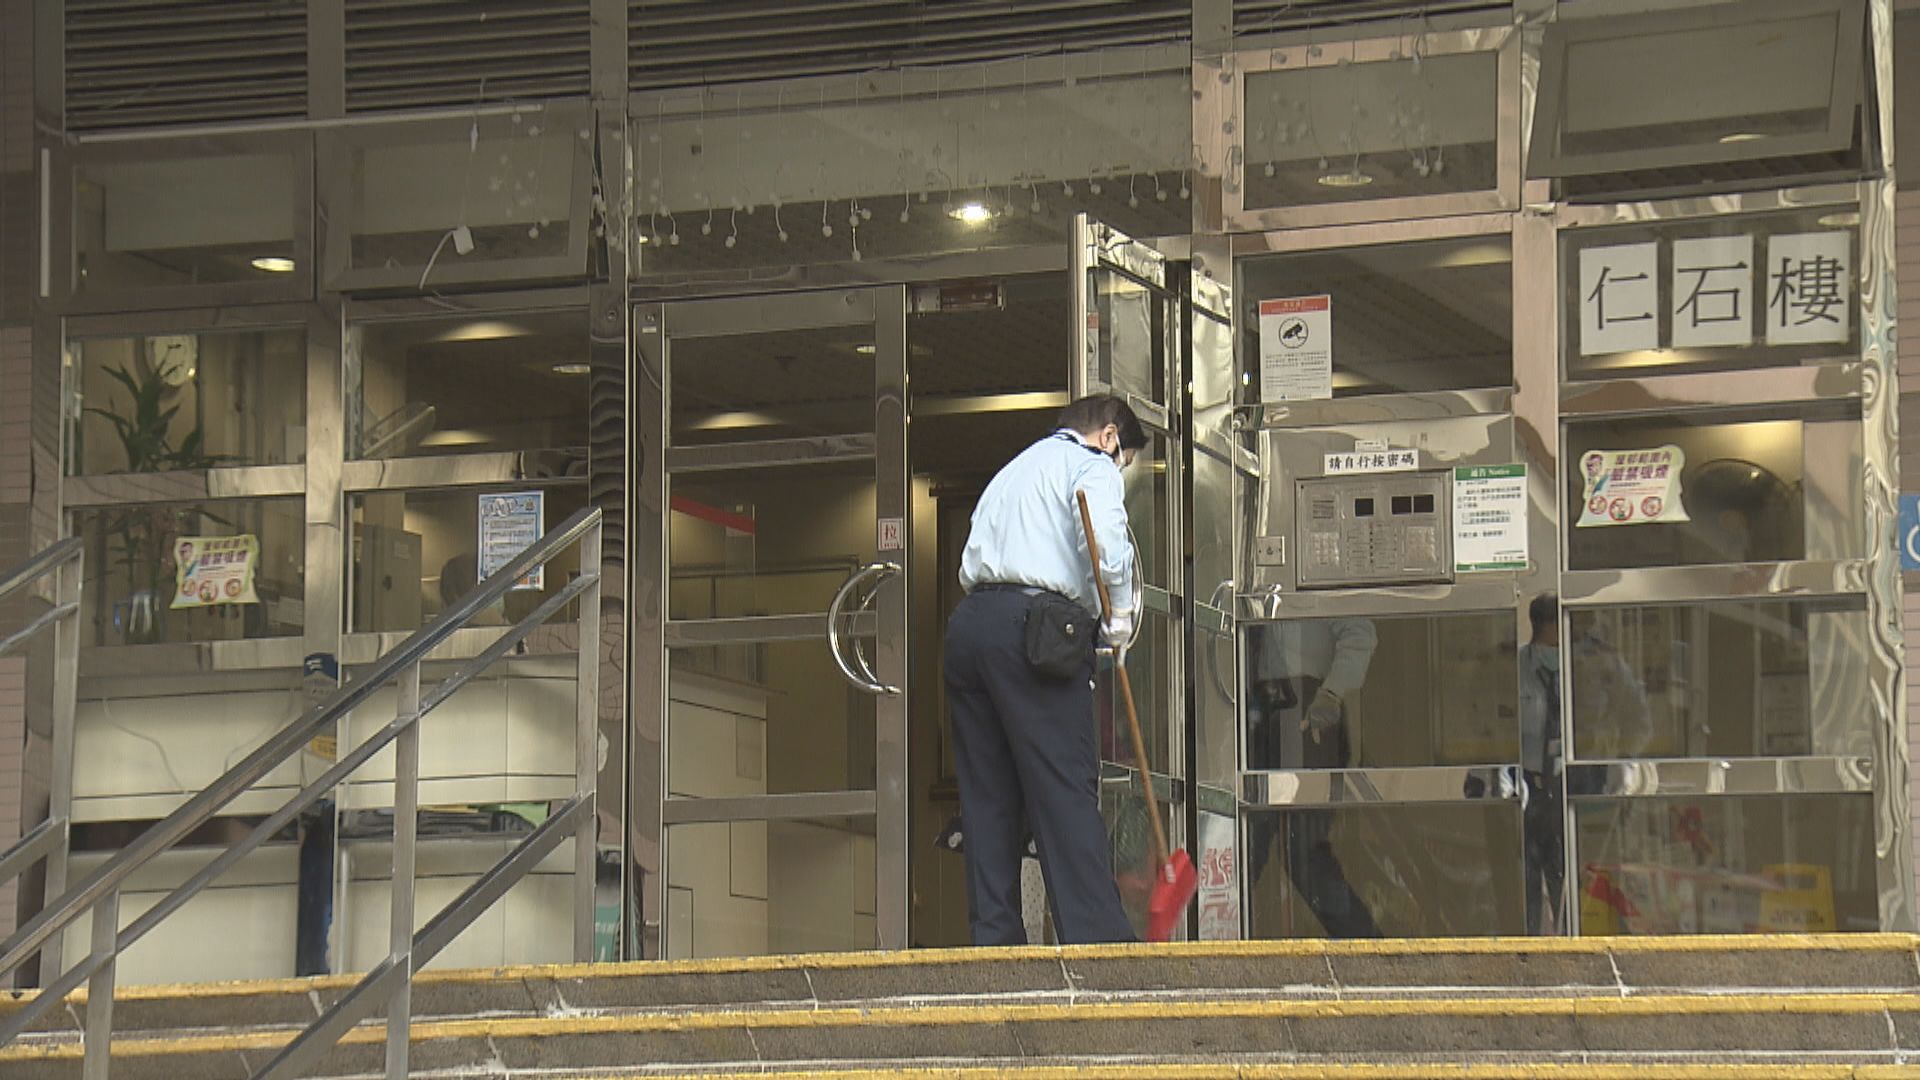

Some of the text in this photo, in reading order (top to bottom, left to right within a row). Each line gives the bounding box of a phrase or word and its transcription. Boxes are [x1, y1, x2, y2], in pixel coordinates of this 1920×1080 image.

[1587, 254, 1845, 331] 仁石樓
[1328, 452, 1415, 470] 請自行按密碼
